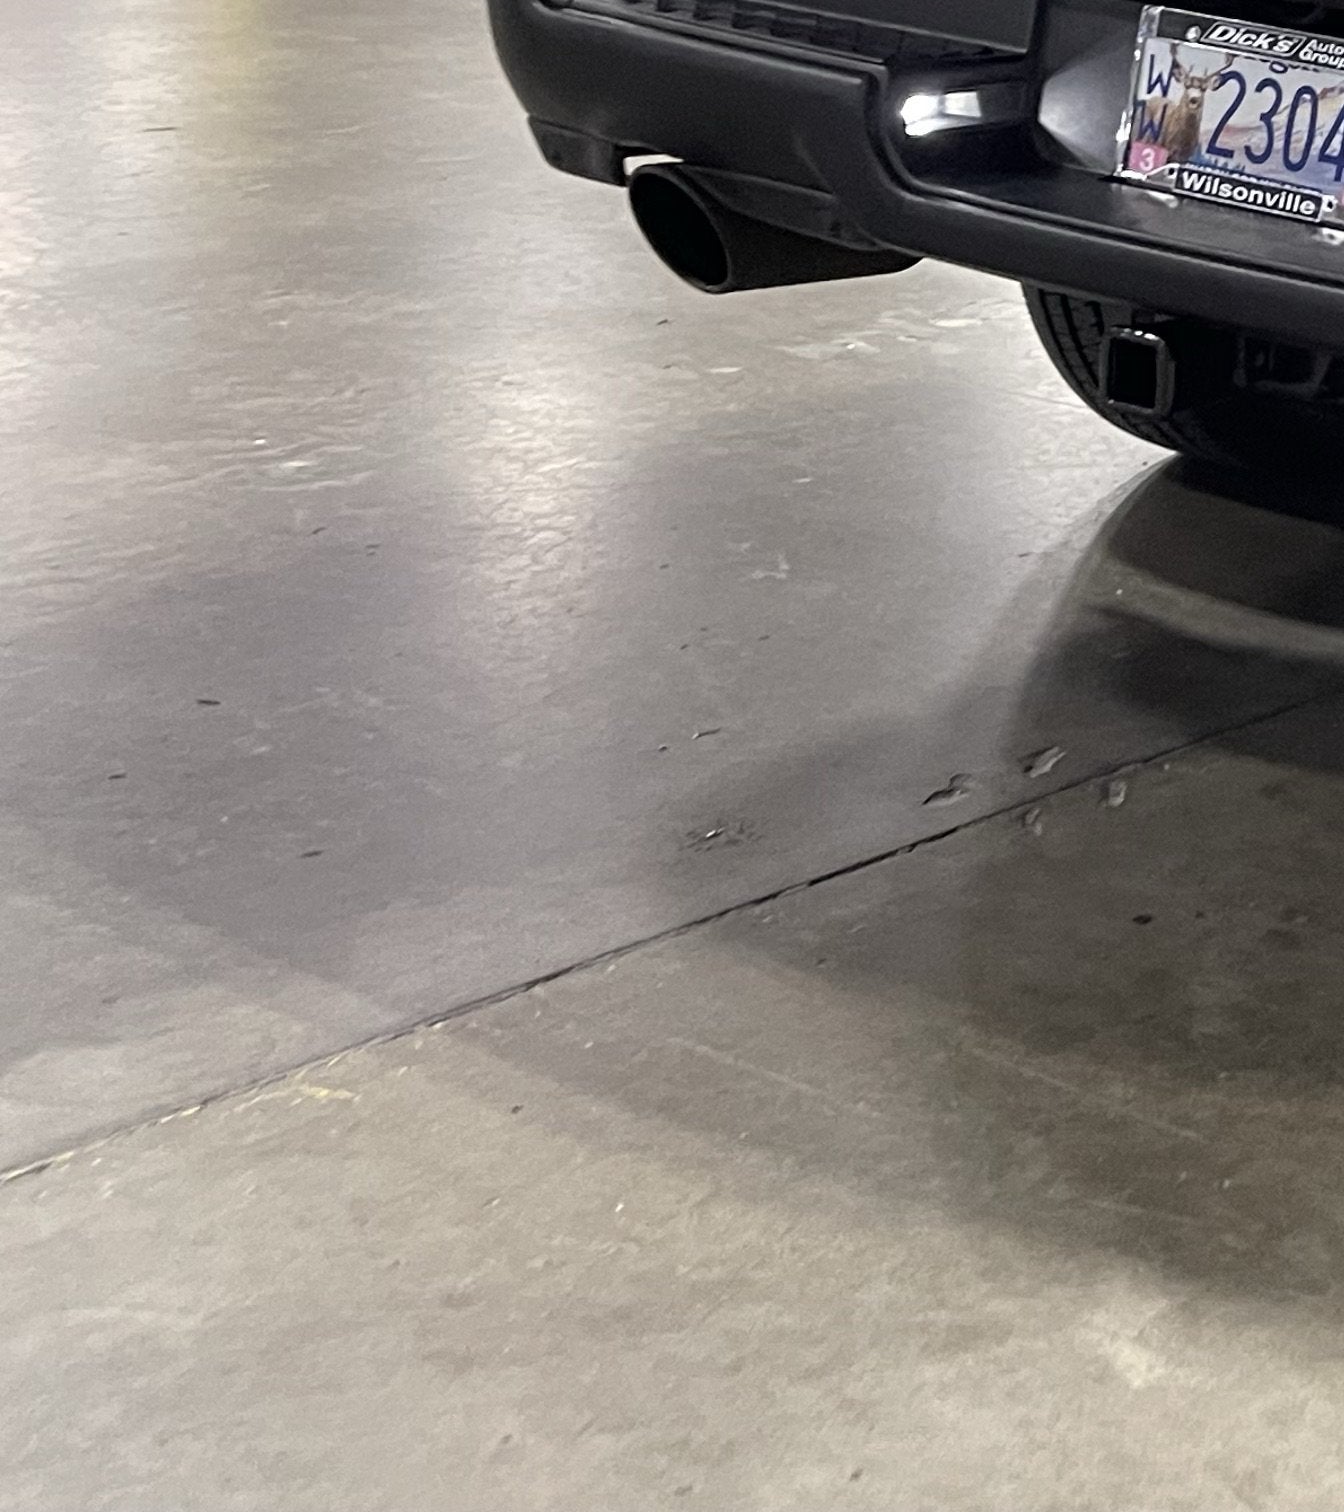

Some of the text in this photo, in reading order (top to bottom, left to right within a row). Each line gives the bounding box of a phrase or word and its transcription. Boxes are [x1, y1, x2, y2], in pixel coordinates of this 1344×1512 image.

[1208, 24, 1296, 54] Dick's
[1140, 149, 1156, 172] 3
[1181, 170, 1317, 216] Wilsonville
